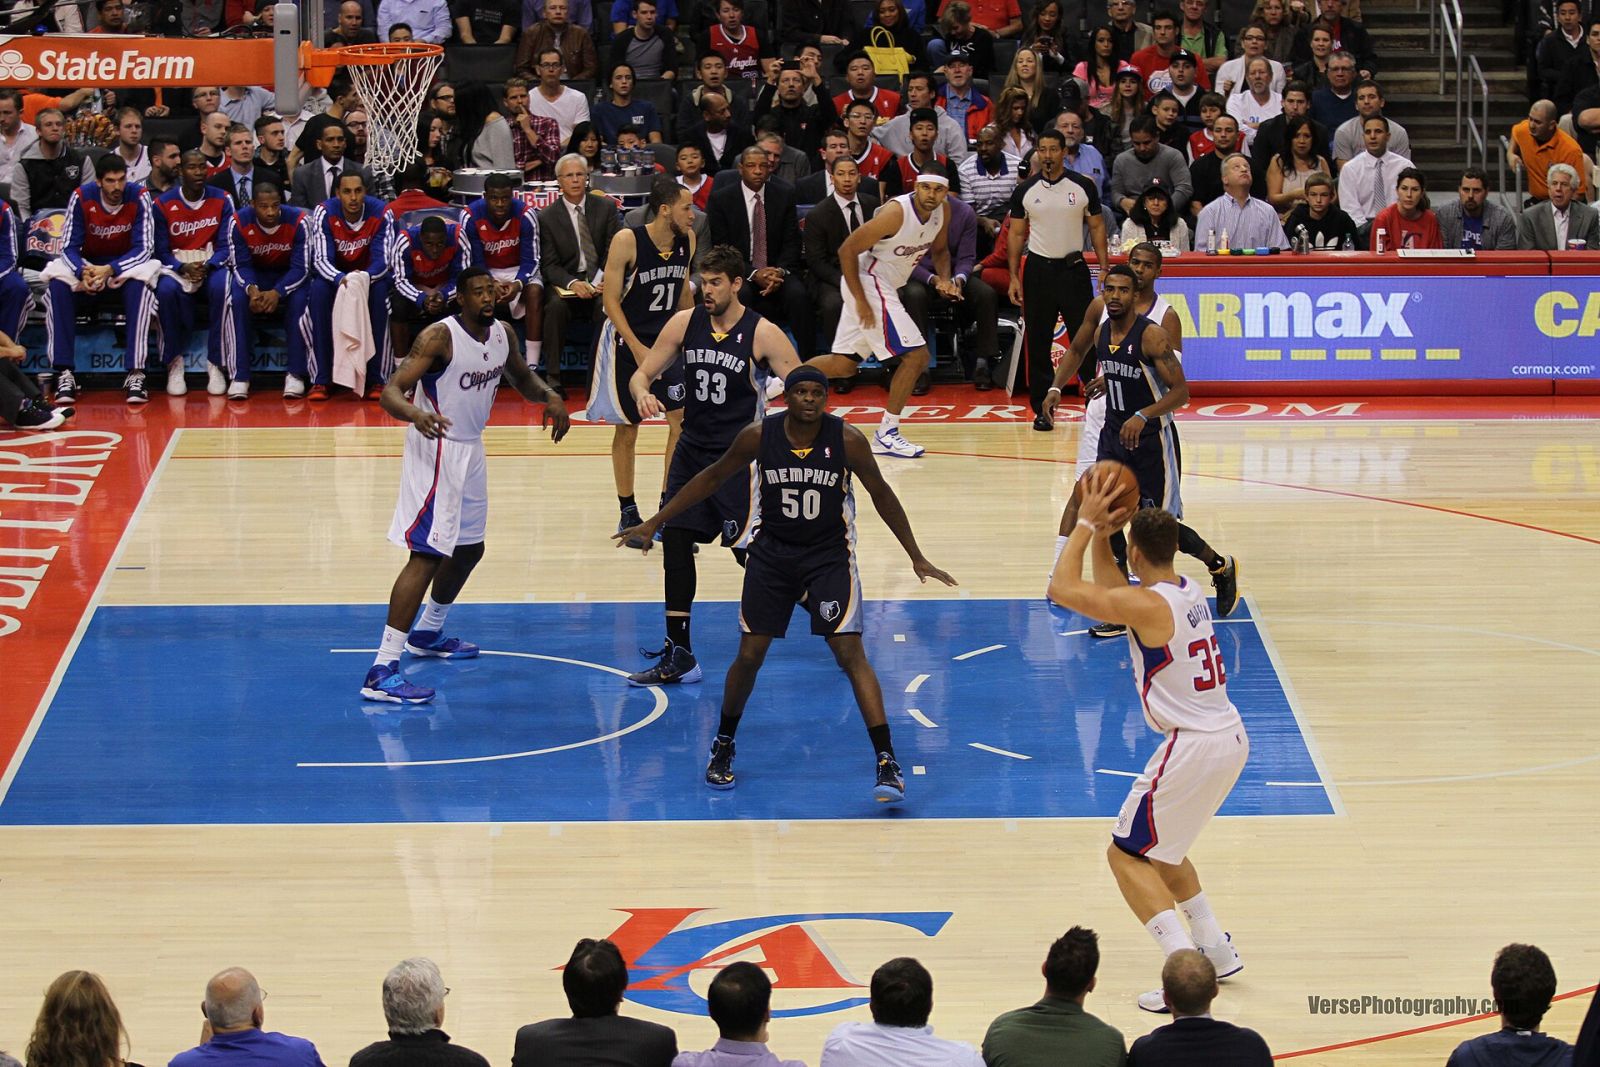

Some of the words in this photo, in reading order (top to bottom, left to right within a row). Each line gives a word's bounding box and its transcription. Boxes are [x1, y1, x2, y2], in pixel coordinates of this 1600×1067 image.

[37, 50, 117, 81] State
[118, 50, 195, 81] Farm
[88, 222, 132, 239] Clippers
[170, 216, 219, 237] Clippers
[638, 264, 688, 285] MEMPHIS
[648, 282, 676, 312] 21
[685, 348, 746, 374] MEMPHIS
[1101, 360, 1142, 380] EMPHIS
[694, 368, 728, 406] 33
[1107, 378, 1126, 412] 11
[765, 467, 839, 487] MEMPHIS
[781, 487, 821, 520] 50
